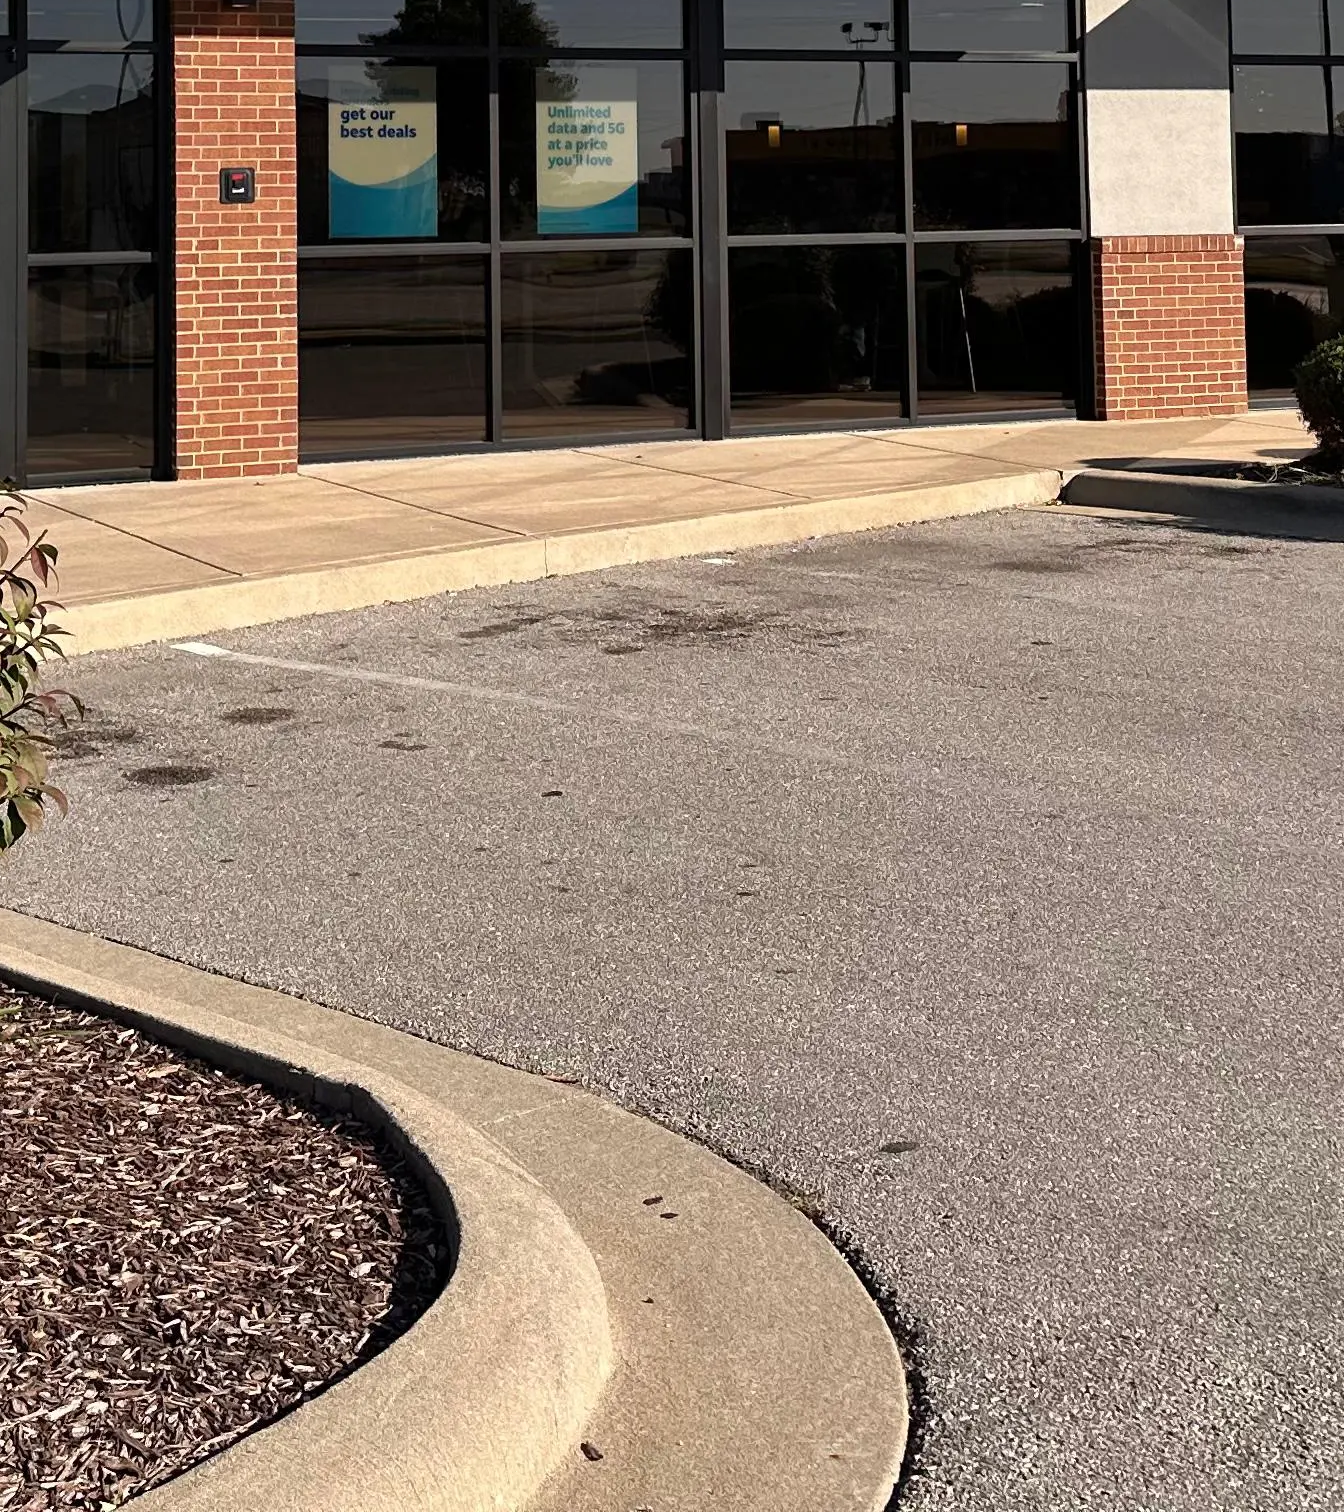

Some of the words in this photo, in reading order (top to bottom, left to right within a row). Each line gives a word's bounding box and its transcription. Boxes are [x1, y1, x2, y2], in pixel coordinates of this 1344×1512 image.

[340, 109, 365, 124] get
[370, 110, 396, 121] our
[548, 106, 611, 118] Unlimited
[340, 125, 373, 138] best
[378, 125, 417, 138] deals
[548, 122, 577, 134] data
[580, 122, 605, 134] and
[608, 123, 625, 134] 5G
[548, 139, 562, 150] at
[565, 141, 573, 150] a
[575, 138, 608, 153] price
[548, 154, 583, 169] you'll
[586, 154, 613, 166] love
